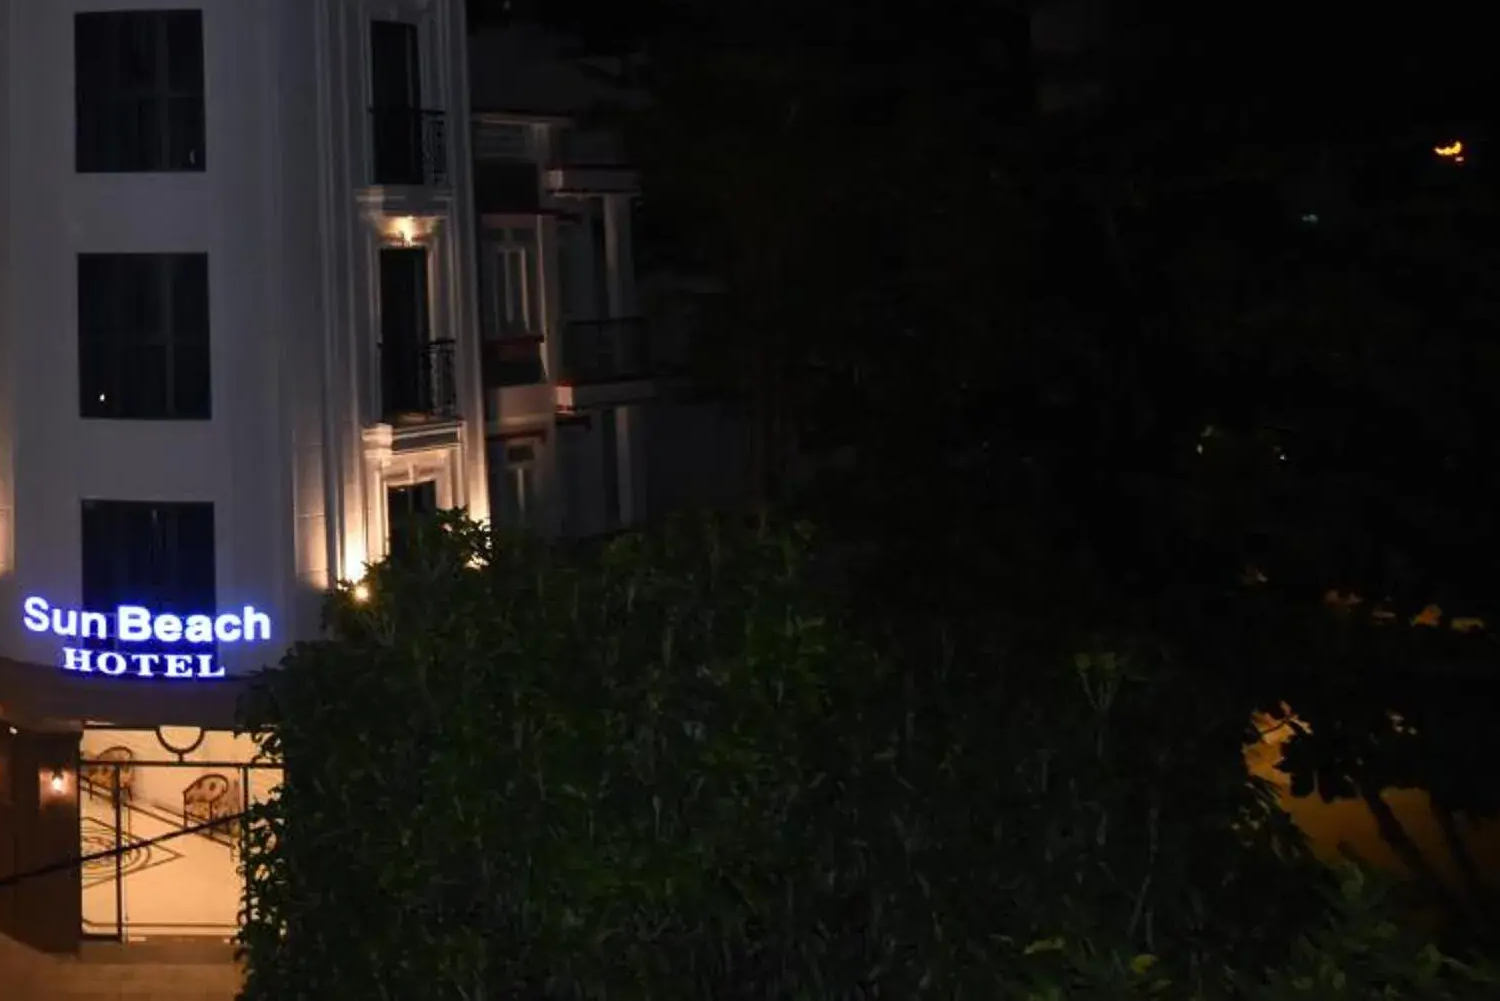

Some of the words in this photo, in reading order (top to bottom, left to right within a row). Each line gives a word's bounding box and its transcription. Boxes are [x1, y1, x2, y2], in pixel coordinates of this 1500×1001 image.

[23, 596, 108, 639] Sun
[117, 605, 271, 642] Beach
[62, 647, 225, 677] HOTEL
